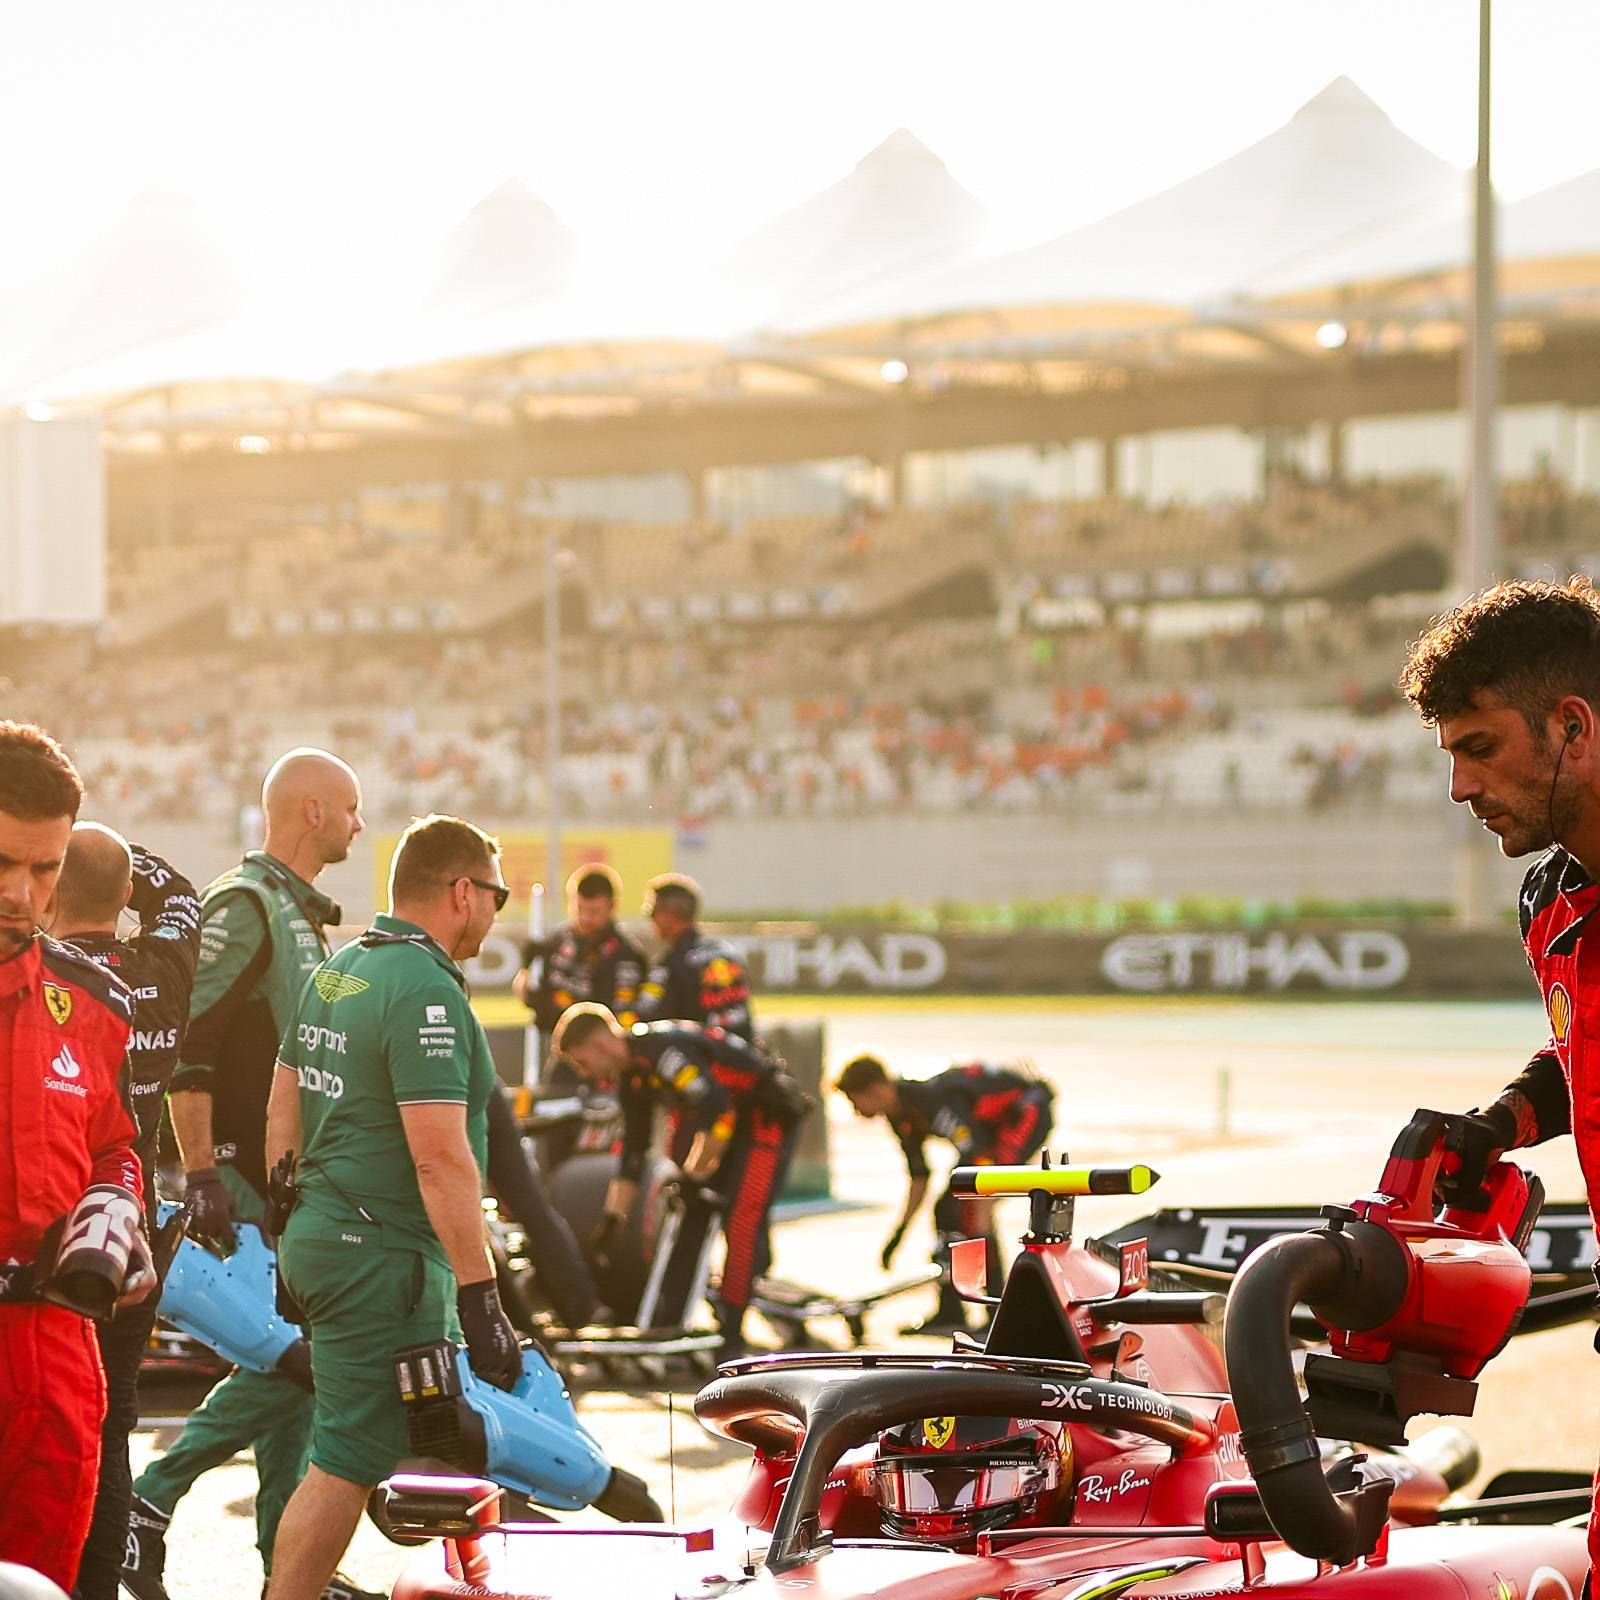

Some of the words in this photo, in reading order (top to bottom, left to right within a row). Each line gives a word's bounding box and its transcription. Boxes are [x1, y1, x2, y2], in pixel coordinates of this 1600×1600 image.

[738, 933, 948, 990] TIHAD
[1102, 931, 1409, 990] ETIHAD
[131, 986, 158, 1000] MG
[125, 1028, 178, 1050] ONAS
[44, 1076, 89, 1098] Santander
[1040, 1383, 1093, 1411] DXC
[1098, 1393, 1174, 1421] TECHNOLOGY
[1078, 1469, 1150, 1503] Ray-Ban
